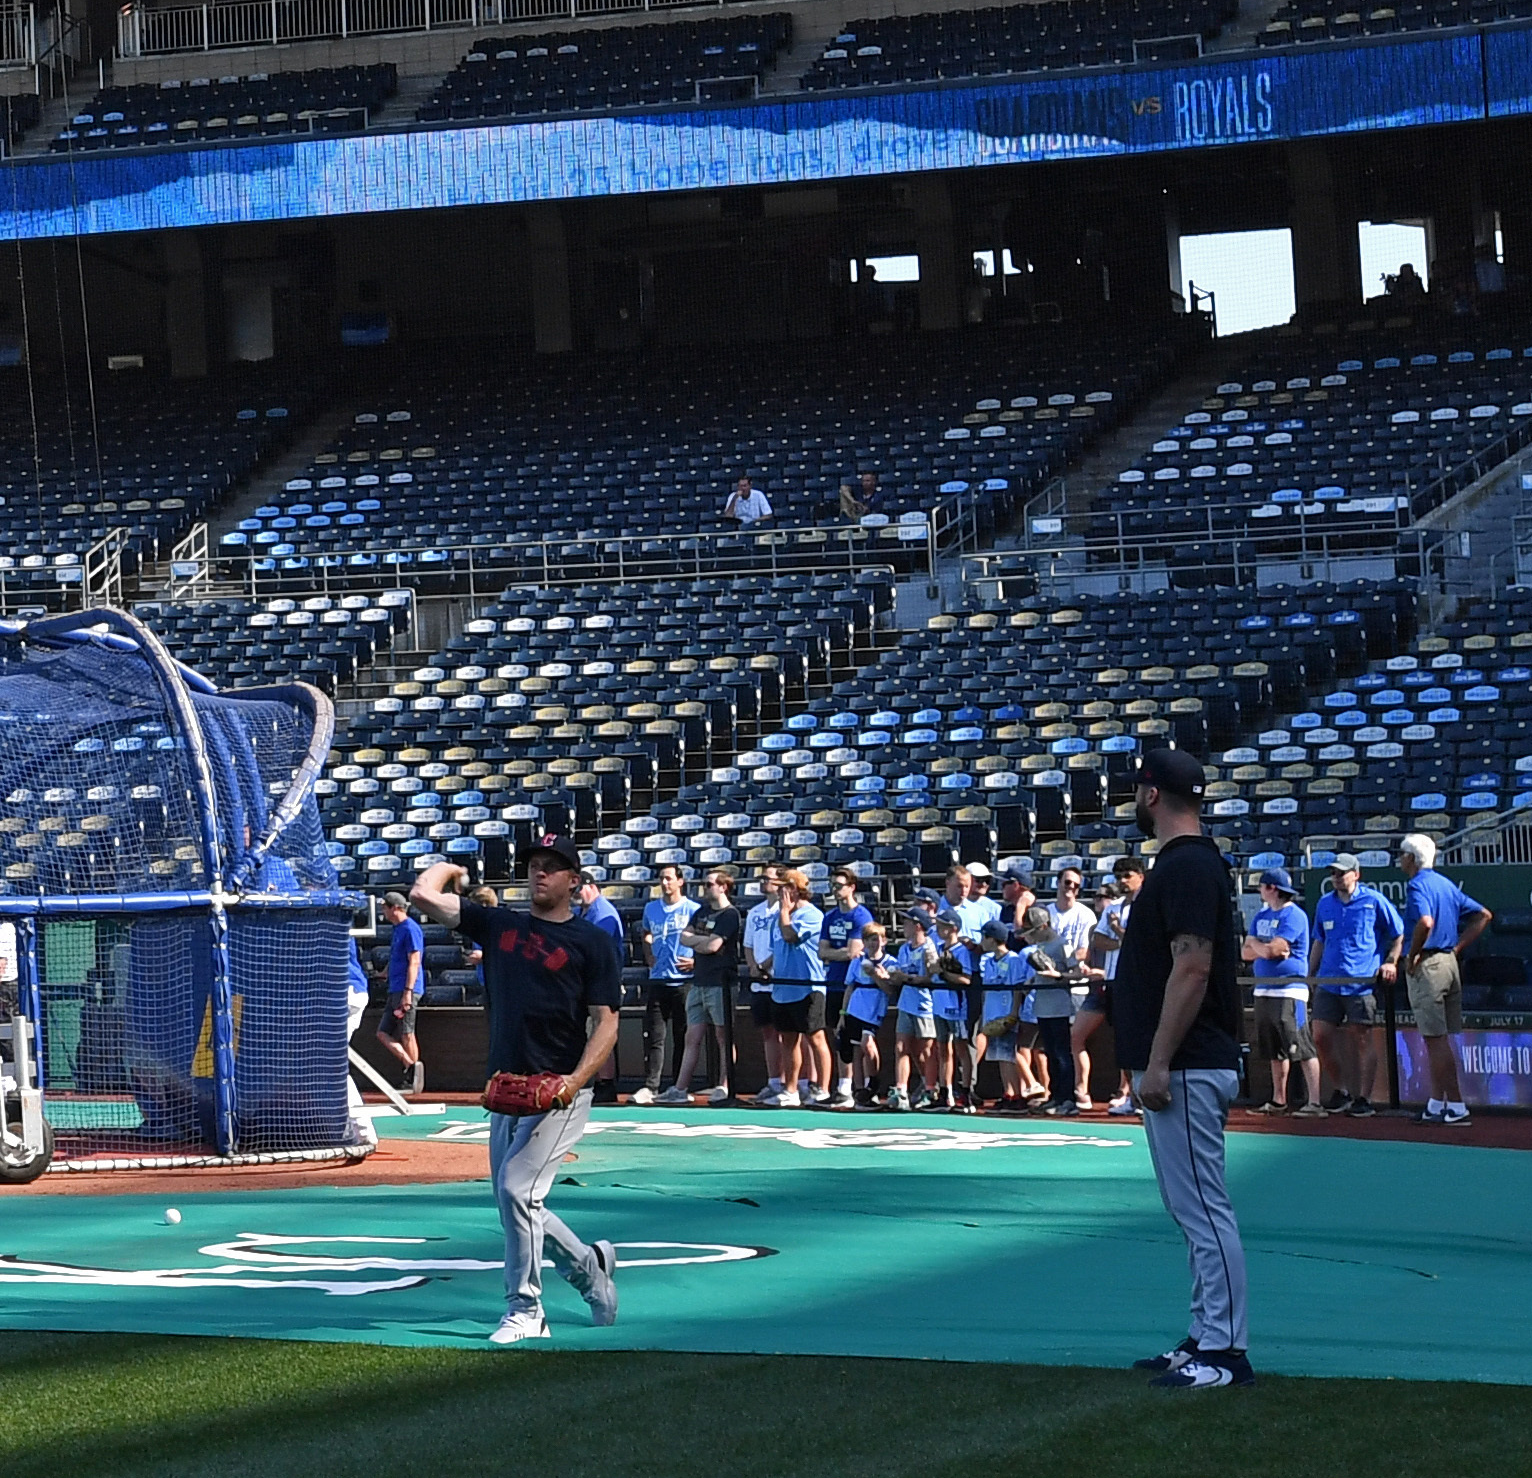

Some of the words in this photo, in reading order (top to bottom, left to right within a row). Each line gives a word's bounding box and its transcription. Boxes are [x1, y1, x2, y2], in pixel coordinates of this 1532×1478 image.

[1174, 72, 1271, 140] ROYALS
[541, 833, 558, 847] C
[1490, 1016, 1511, 1027] JULY
[1514, 1016, 1524, 1026] 17
[1462, 1045, 1513, 1075] WELCOME
[1517, 1046, 1530, 1075] TO
